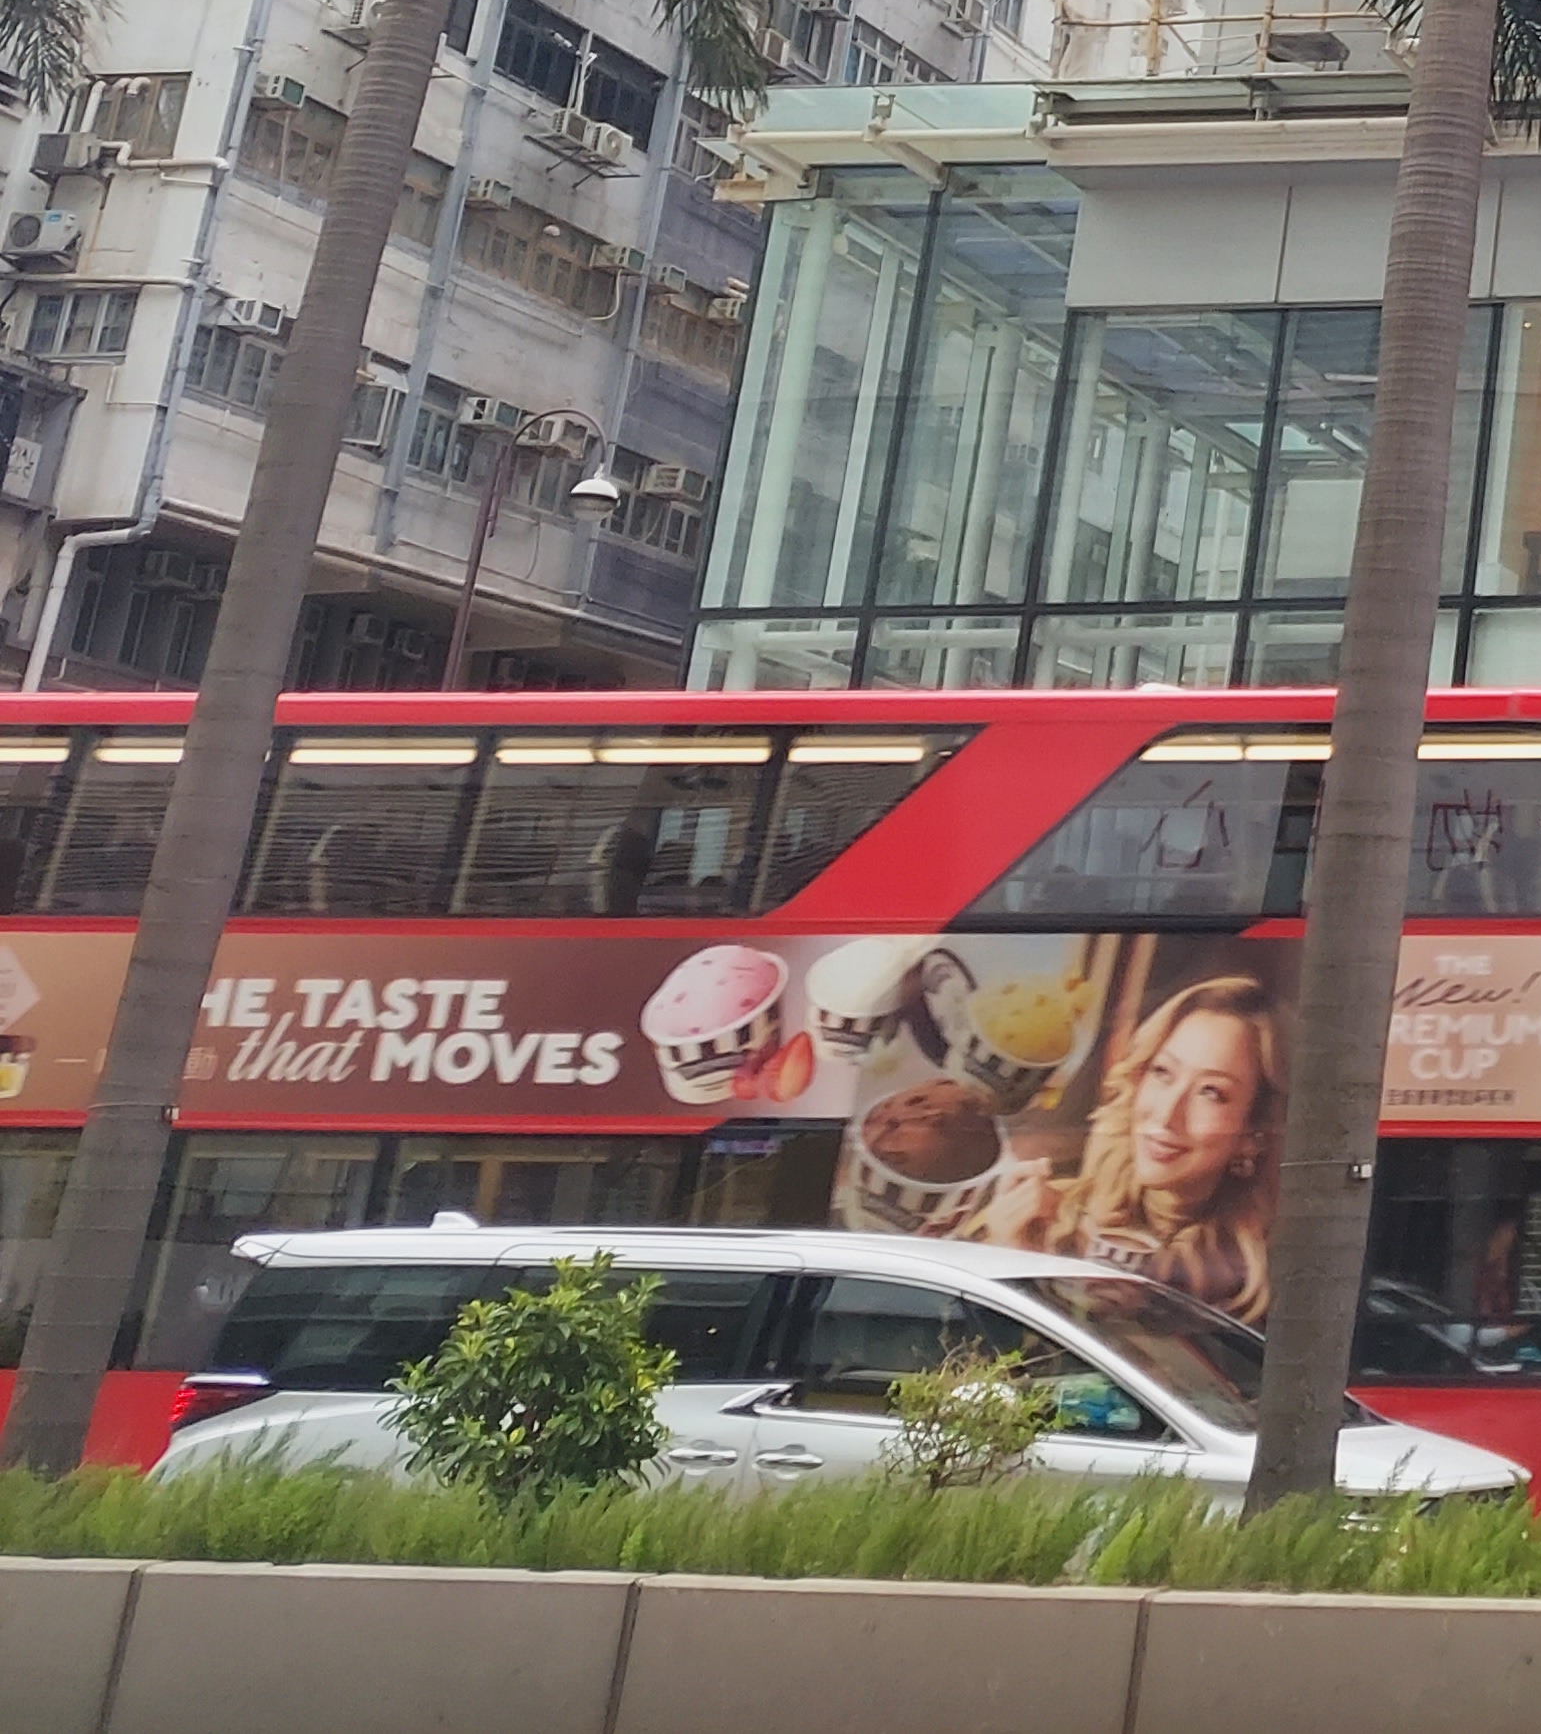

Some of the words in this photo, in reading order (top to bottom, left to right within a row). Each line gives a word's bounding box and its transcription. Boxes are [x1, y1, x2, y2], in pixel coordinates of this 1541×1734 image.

[1434, 954, 1493, 976] THE
[201, 978, 275, 1028] HE
[295, 978, 511, 1030] TASTE
[227, 1011, 366, 1082] that
[370, 1031, 625, 1084] MOVES
[1408, 1047, 1500, 1081] CUP
